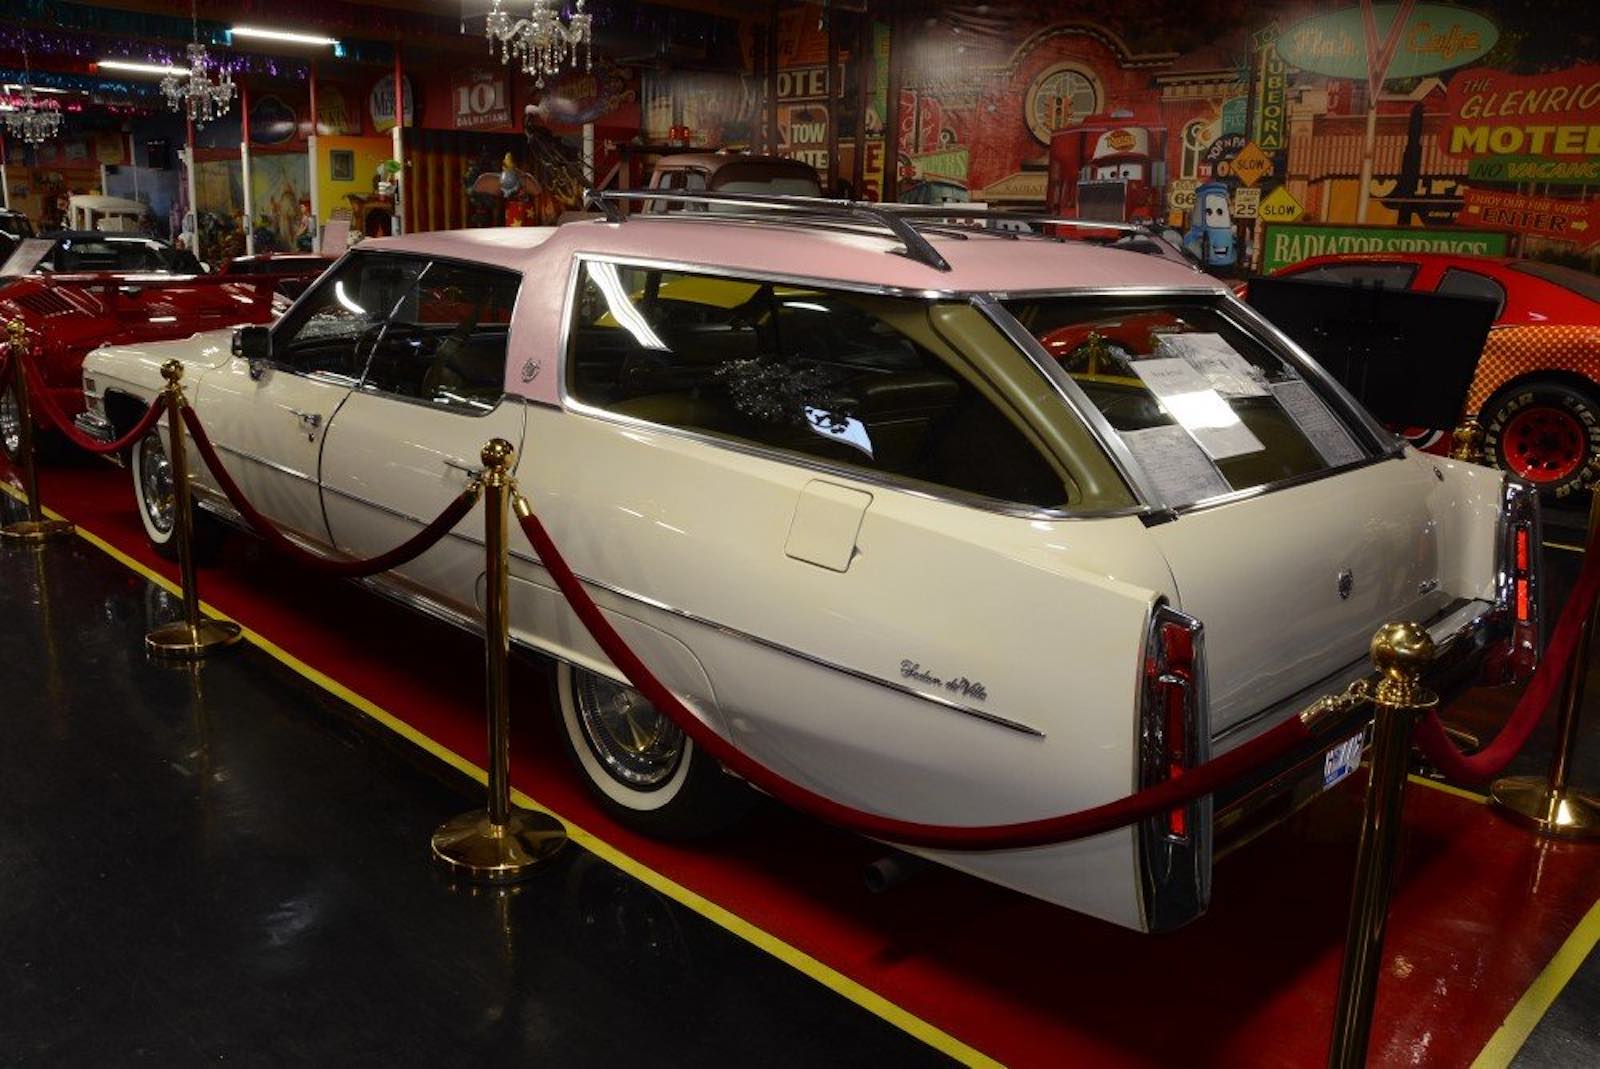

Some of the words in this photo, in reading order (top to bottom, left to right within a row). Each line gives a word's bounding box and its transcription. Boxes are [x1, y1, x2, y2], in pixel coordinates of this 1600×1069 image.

[1463, 78, 1493, 93] THE
[456, 81, 506, 117] 101
[792, 121, 826, 144] TOW
[1237, 158, 1265, 170] SLOW
[1475, 165, 1503, 177] NO
[1174, 193, 1197, 205] 66
[1236, 204, 1257, 216] 25
[1265, 203, 1295, 215] SLOW
[1480, 206, 1568, 233] ENTER
